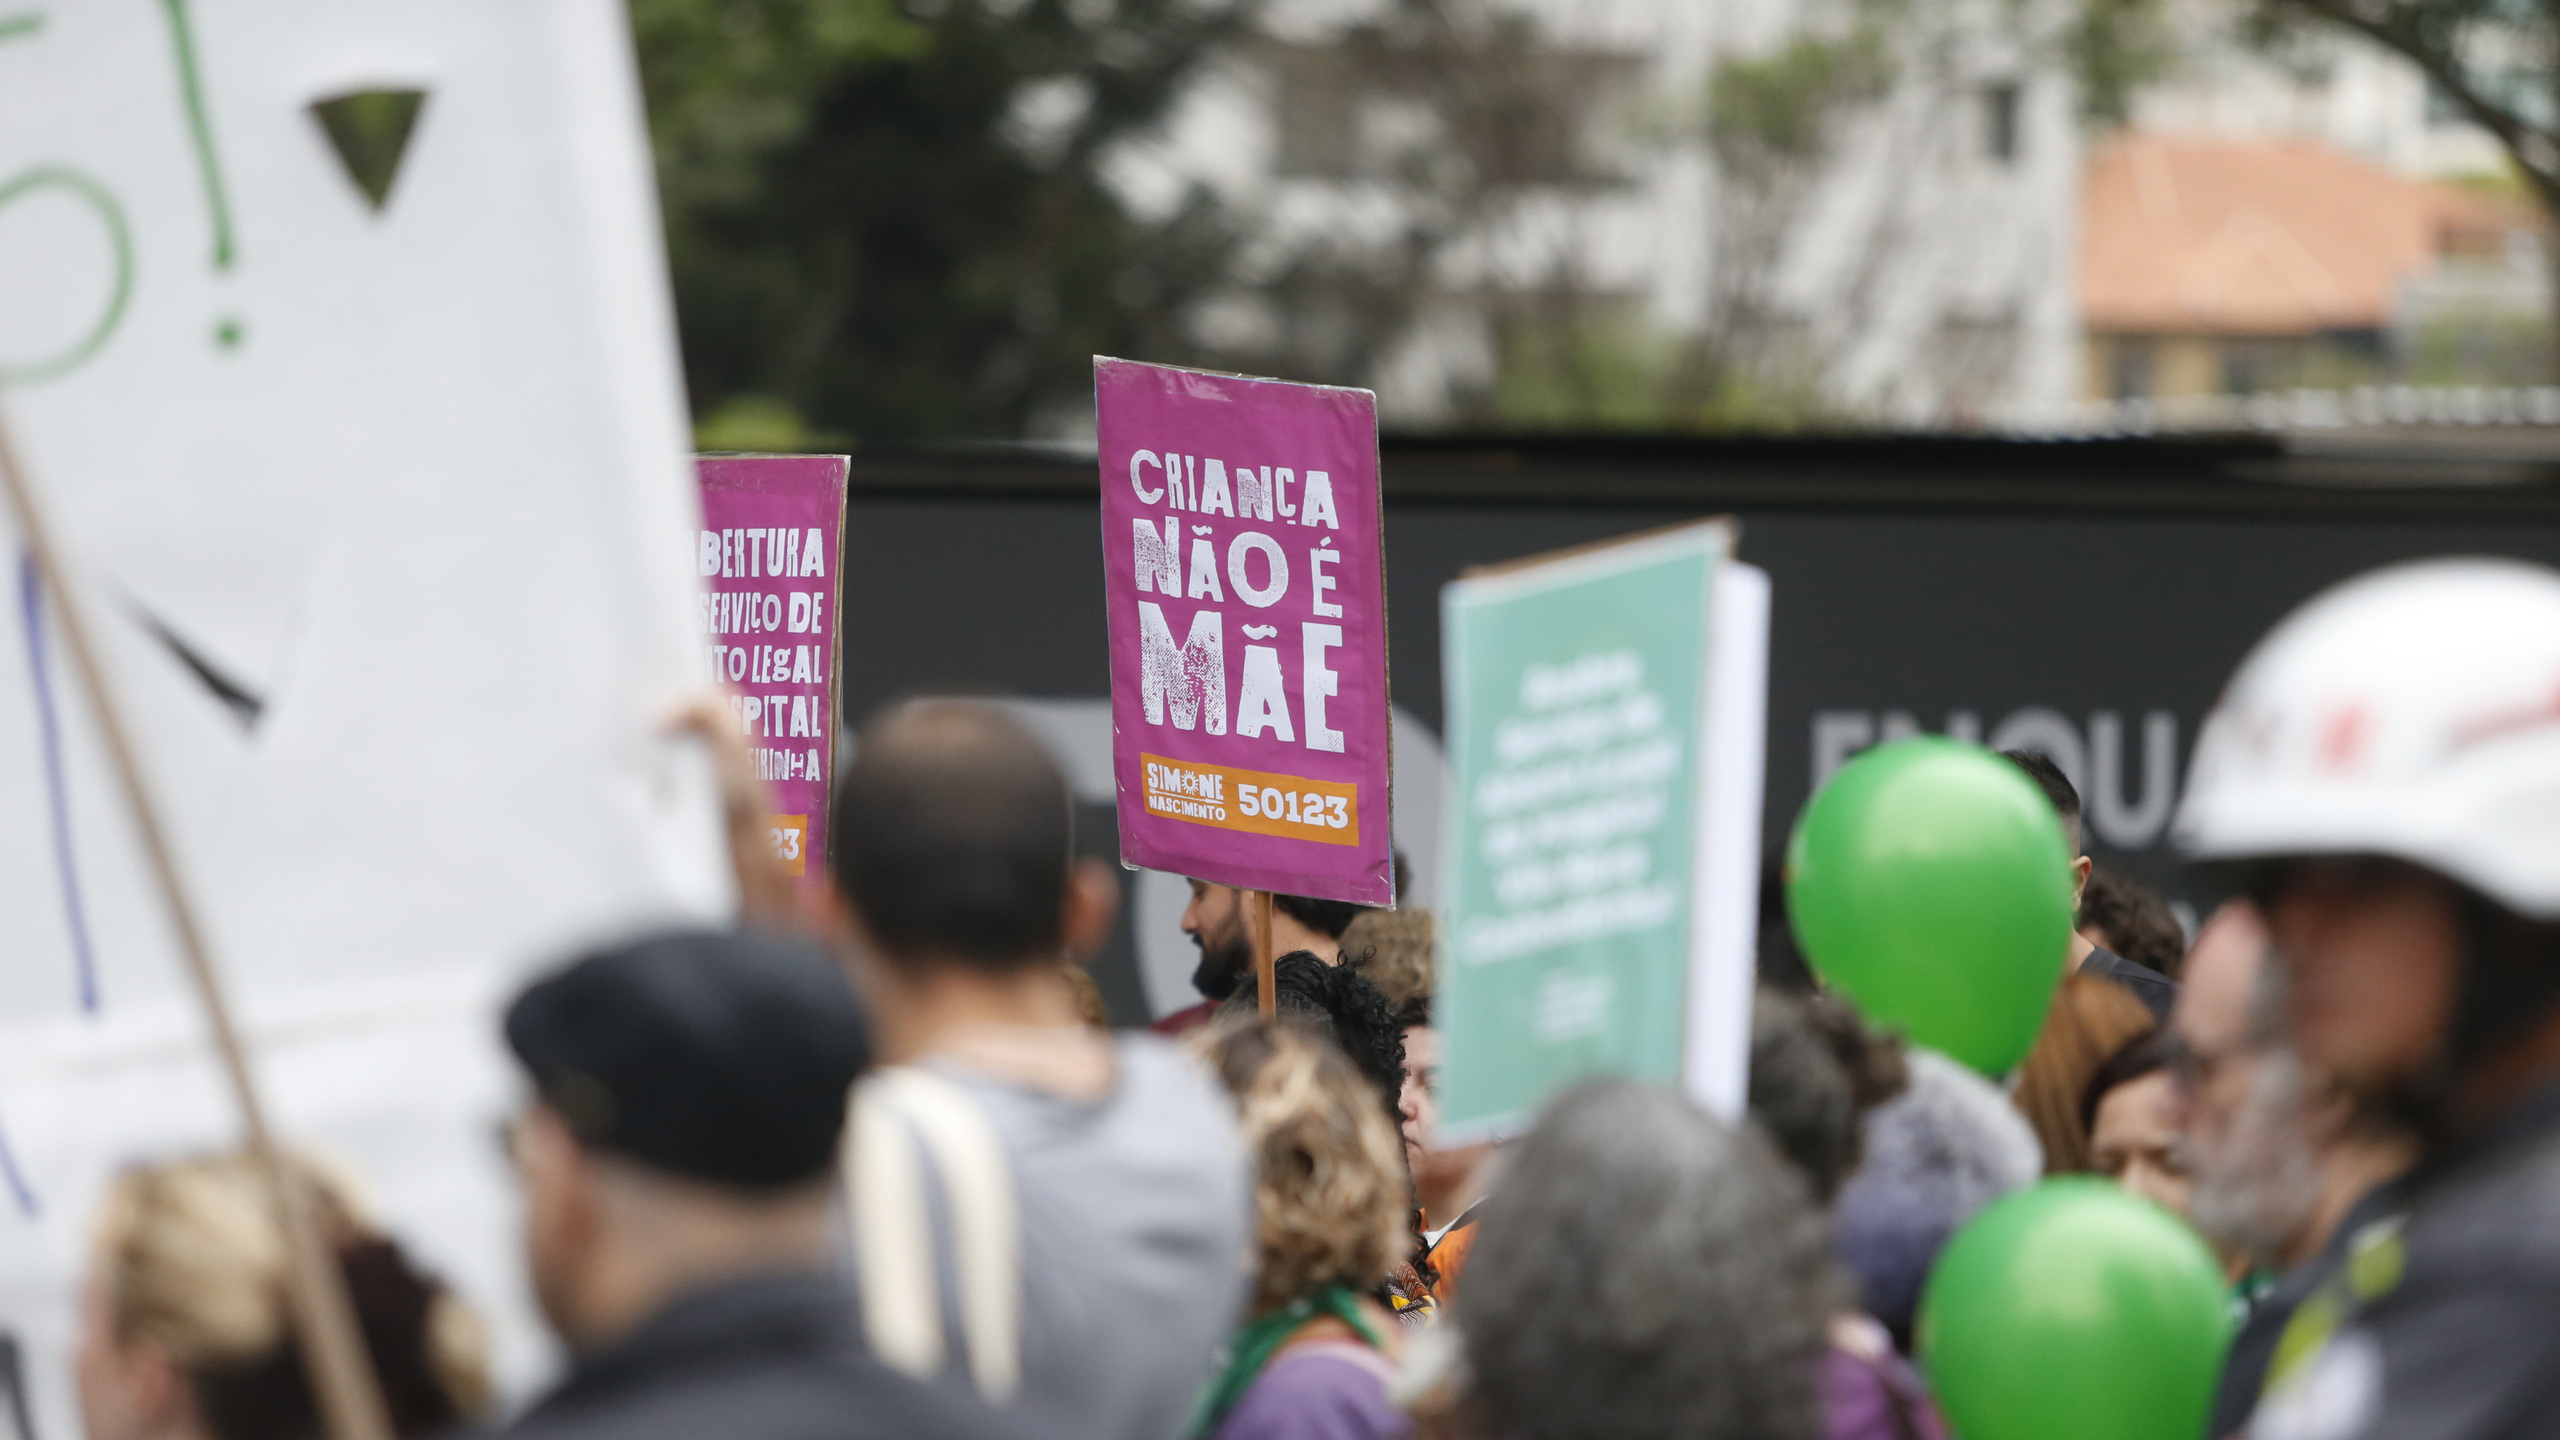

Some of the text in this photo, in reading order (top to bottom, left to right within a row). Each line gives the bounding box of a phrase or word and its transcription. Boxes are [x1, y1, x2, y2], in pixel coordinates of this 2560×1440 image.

[1130, 449, 1339, 529] CRIANÇA
[1132, 515, 1343, 618] NÃO É
[698, 592, 824, 633] SERVIÇO DE
[1137, 600, 1345, 753] MÃE
[1147, 762, 1224, 800] SIMONE
[1149, 795, 1226, 822] NASCIMENTO
[1238, 783, 1348, 829] 50123
